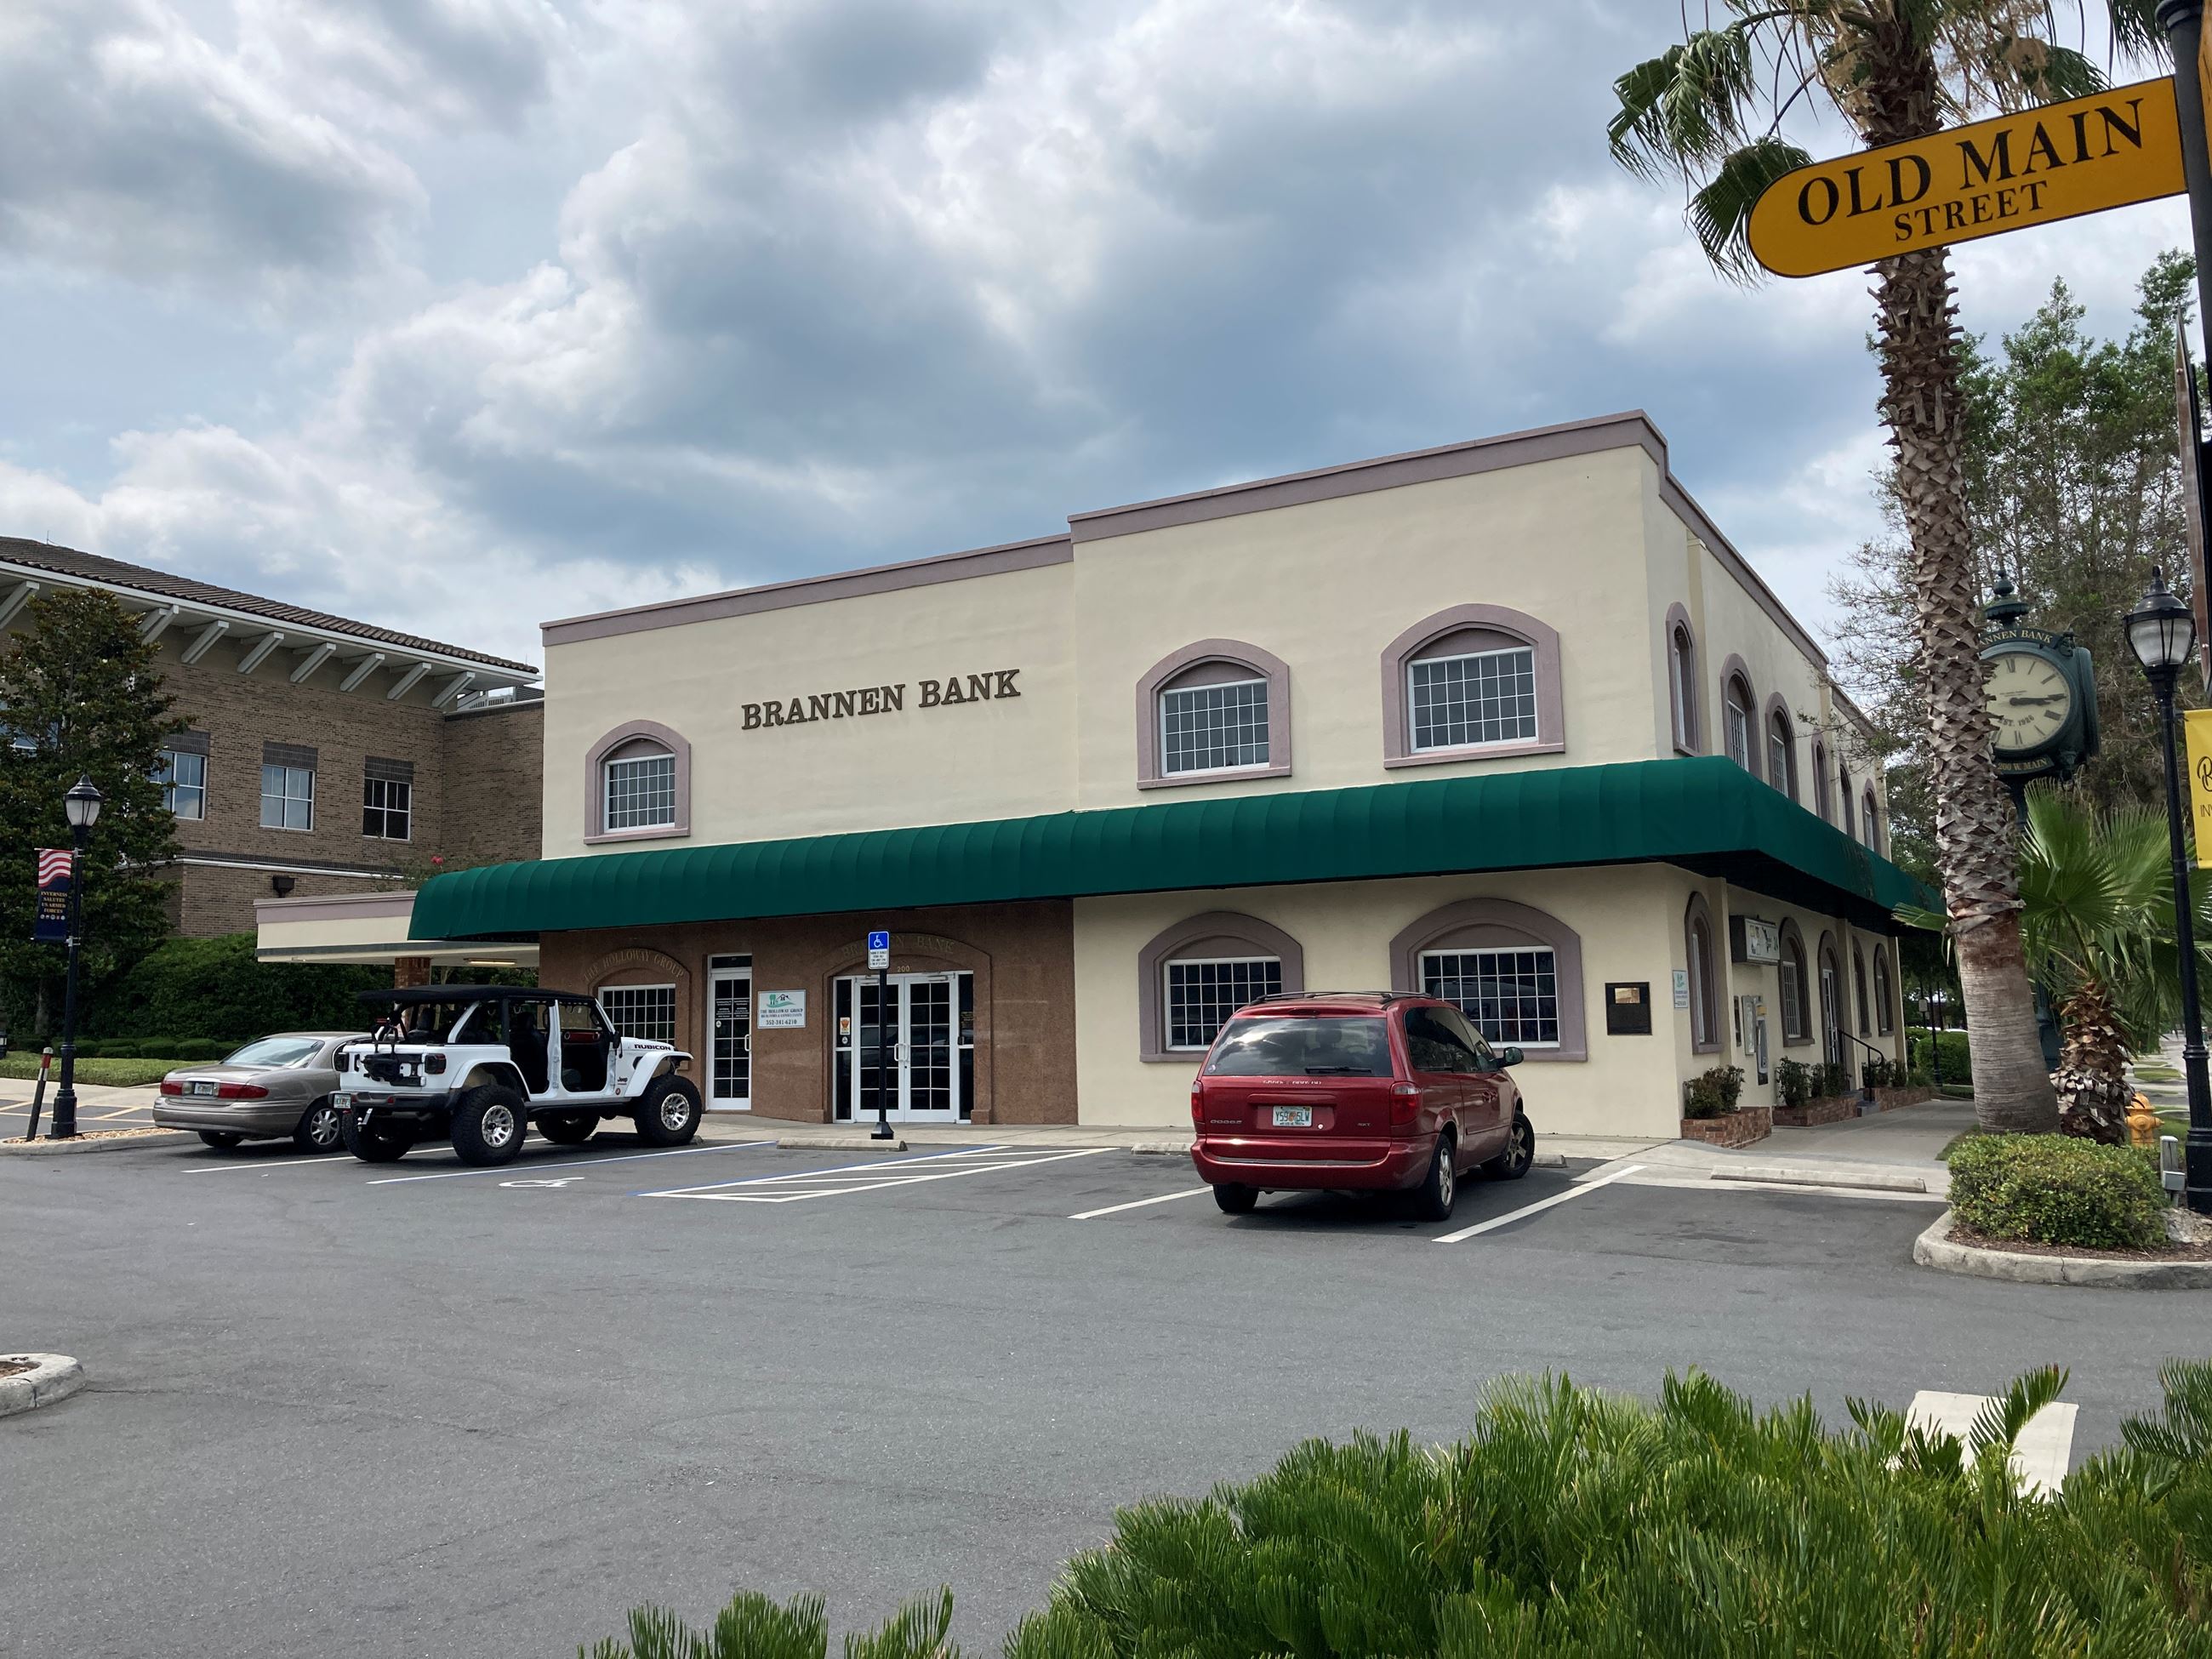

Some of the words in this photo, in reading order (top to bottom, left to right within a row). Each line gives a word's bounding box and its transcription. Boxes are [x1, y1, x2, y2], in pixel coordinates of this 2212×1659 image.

[1798, 154, 1930, 225] OLD
[1957, 98, 2144, 190] MAIN
[1895, 180, 2047, 242] STREET
[1979, 630, 2017, 646] ANNEN
[2021, 630, 2054, 644] BANK
[741, 683, 906, 730] BRANNEN
[918, 669, 1021, 708] BANK
[584, 962, 600, 982] THE
[603, 949, 650, 968] HOLLOWAY
[653, 953, 684, 978] GROUP
